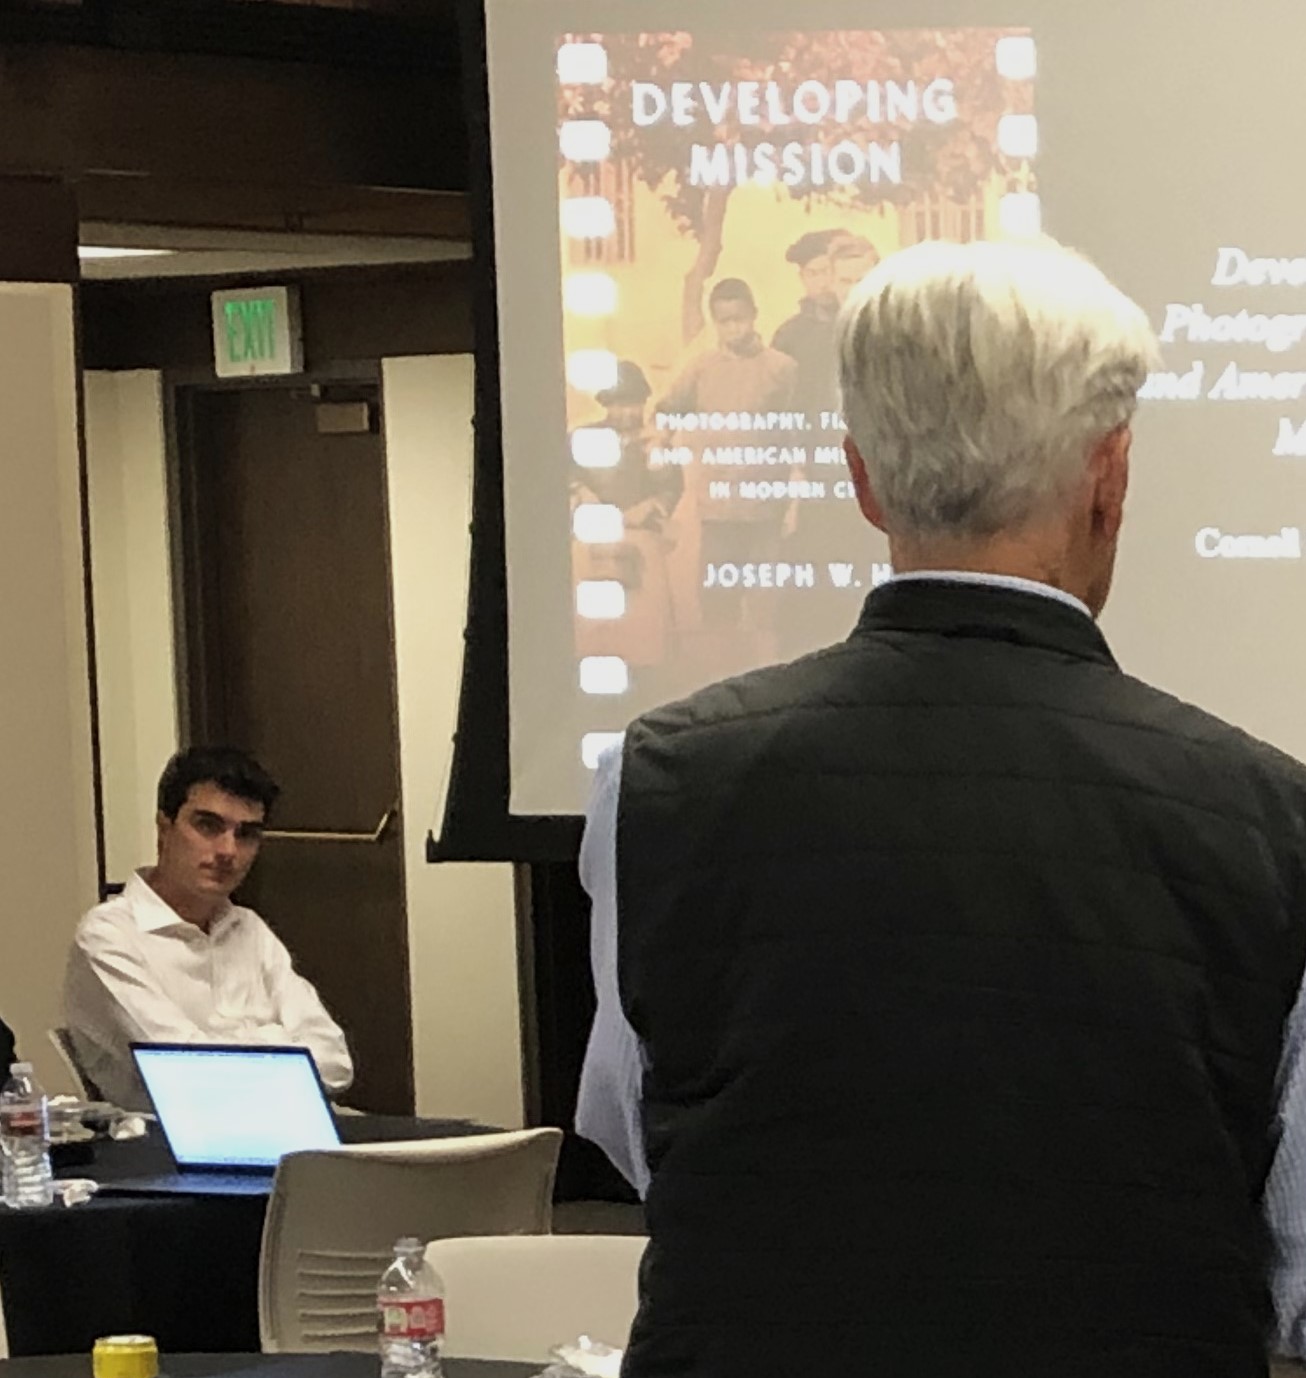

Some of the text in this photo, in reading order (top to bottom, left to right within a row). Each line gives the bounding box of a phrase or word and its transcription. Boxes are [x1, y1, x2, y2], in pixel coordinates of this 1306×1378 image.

[631, 79, 957, 126] DEVELOPING
[690, 141, 901, 187] MISSION
[650, 447, 693, 465] AND
[702, 447, 806, 465] AMERICAN
[710, 482, 731, 499] IN
[739, 481, 826, 499] MODERN
[1195, 528, 1300, 559] Cornell
[704, 563, 814, 588] JOSEPH
[828, 563, 861, 588] W.
